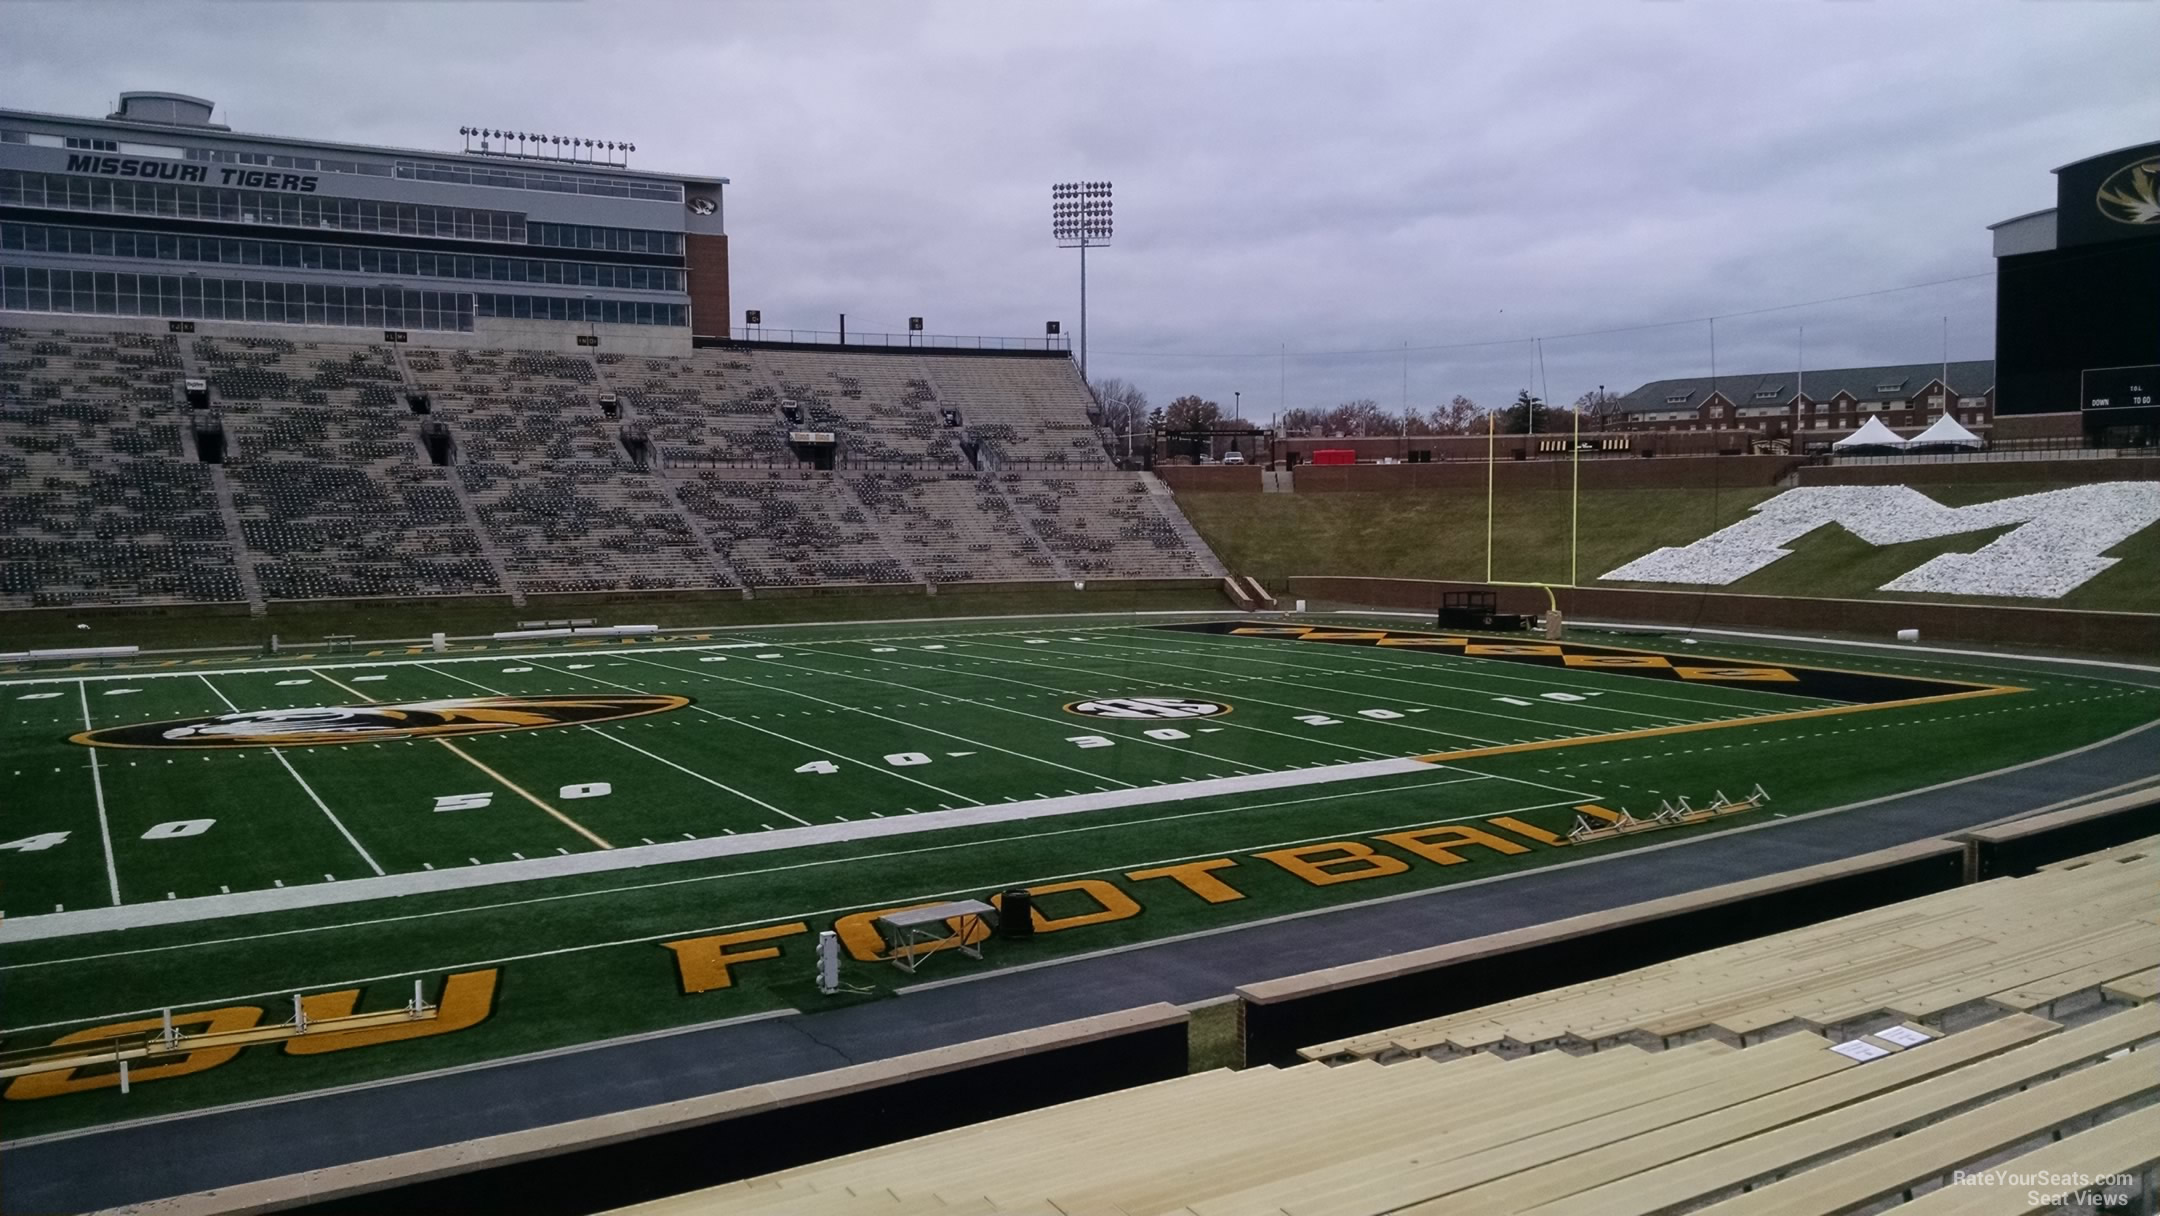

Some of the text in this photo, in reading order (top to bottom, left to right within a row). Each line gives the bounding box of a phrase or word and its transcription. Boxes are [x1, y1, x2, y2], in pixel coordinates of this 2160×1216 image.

[66, 154, 319, 193] MISSOURI TIGERS
[2091, 398, 2110, 407] DOWN
[2132, 396, 2141, 405] TO
